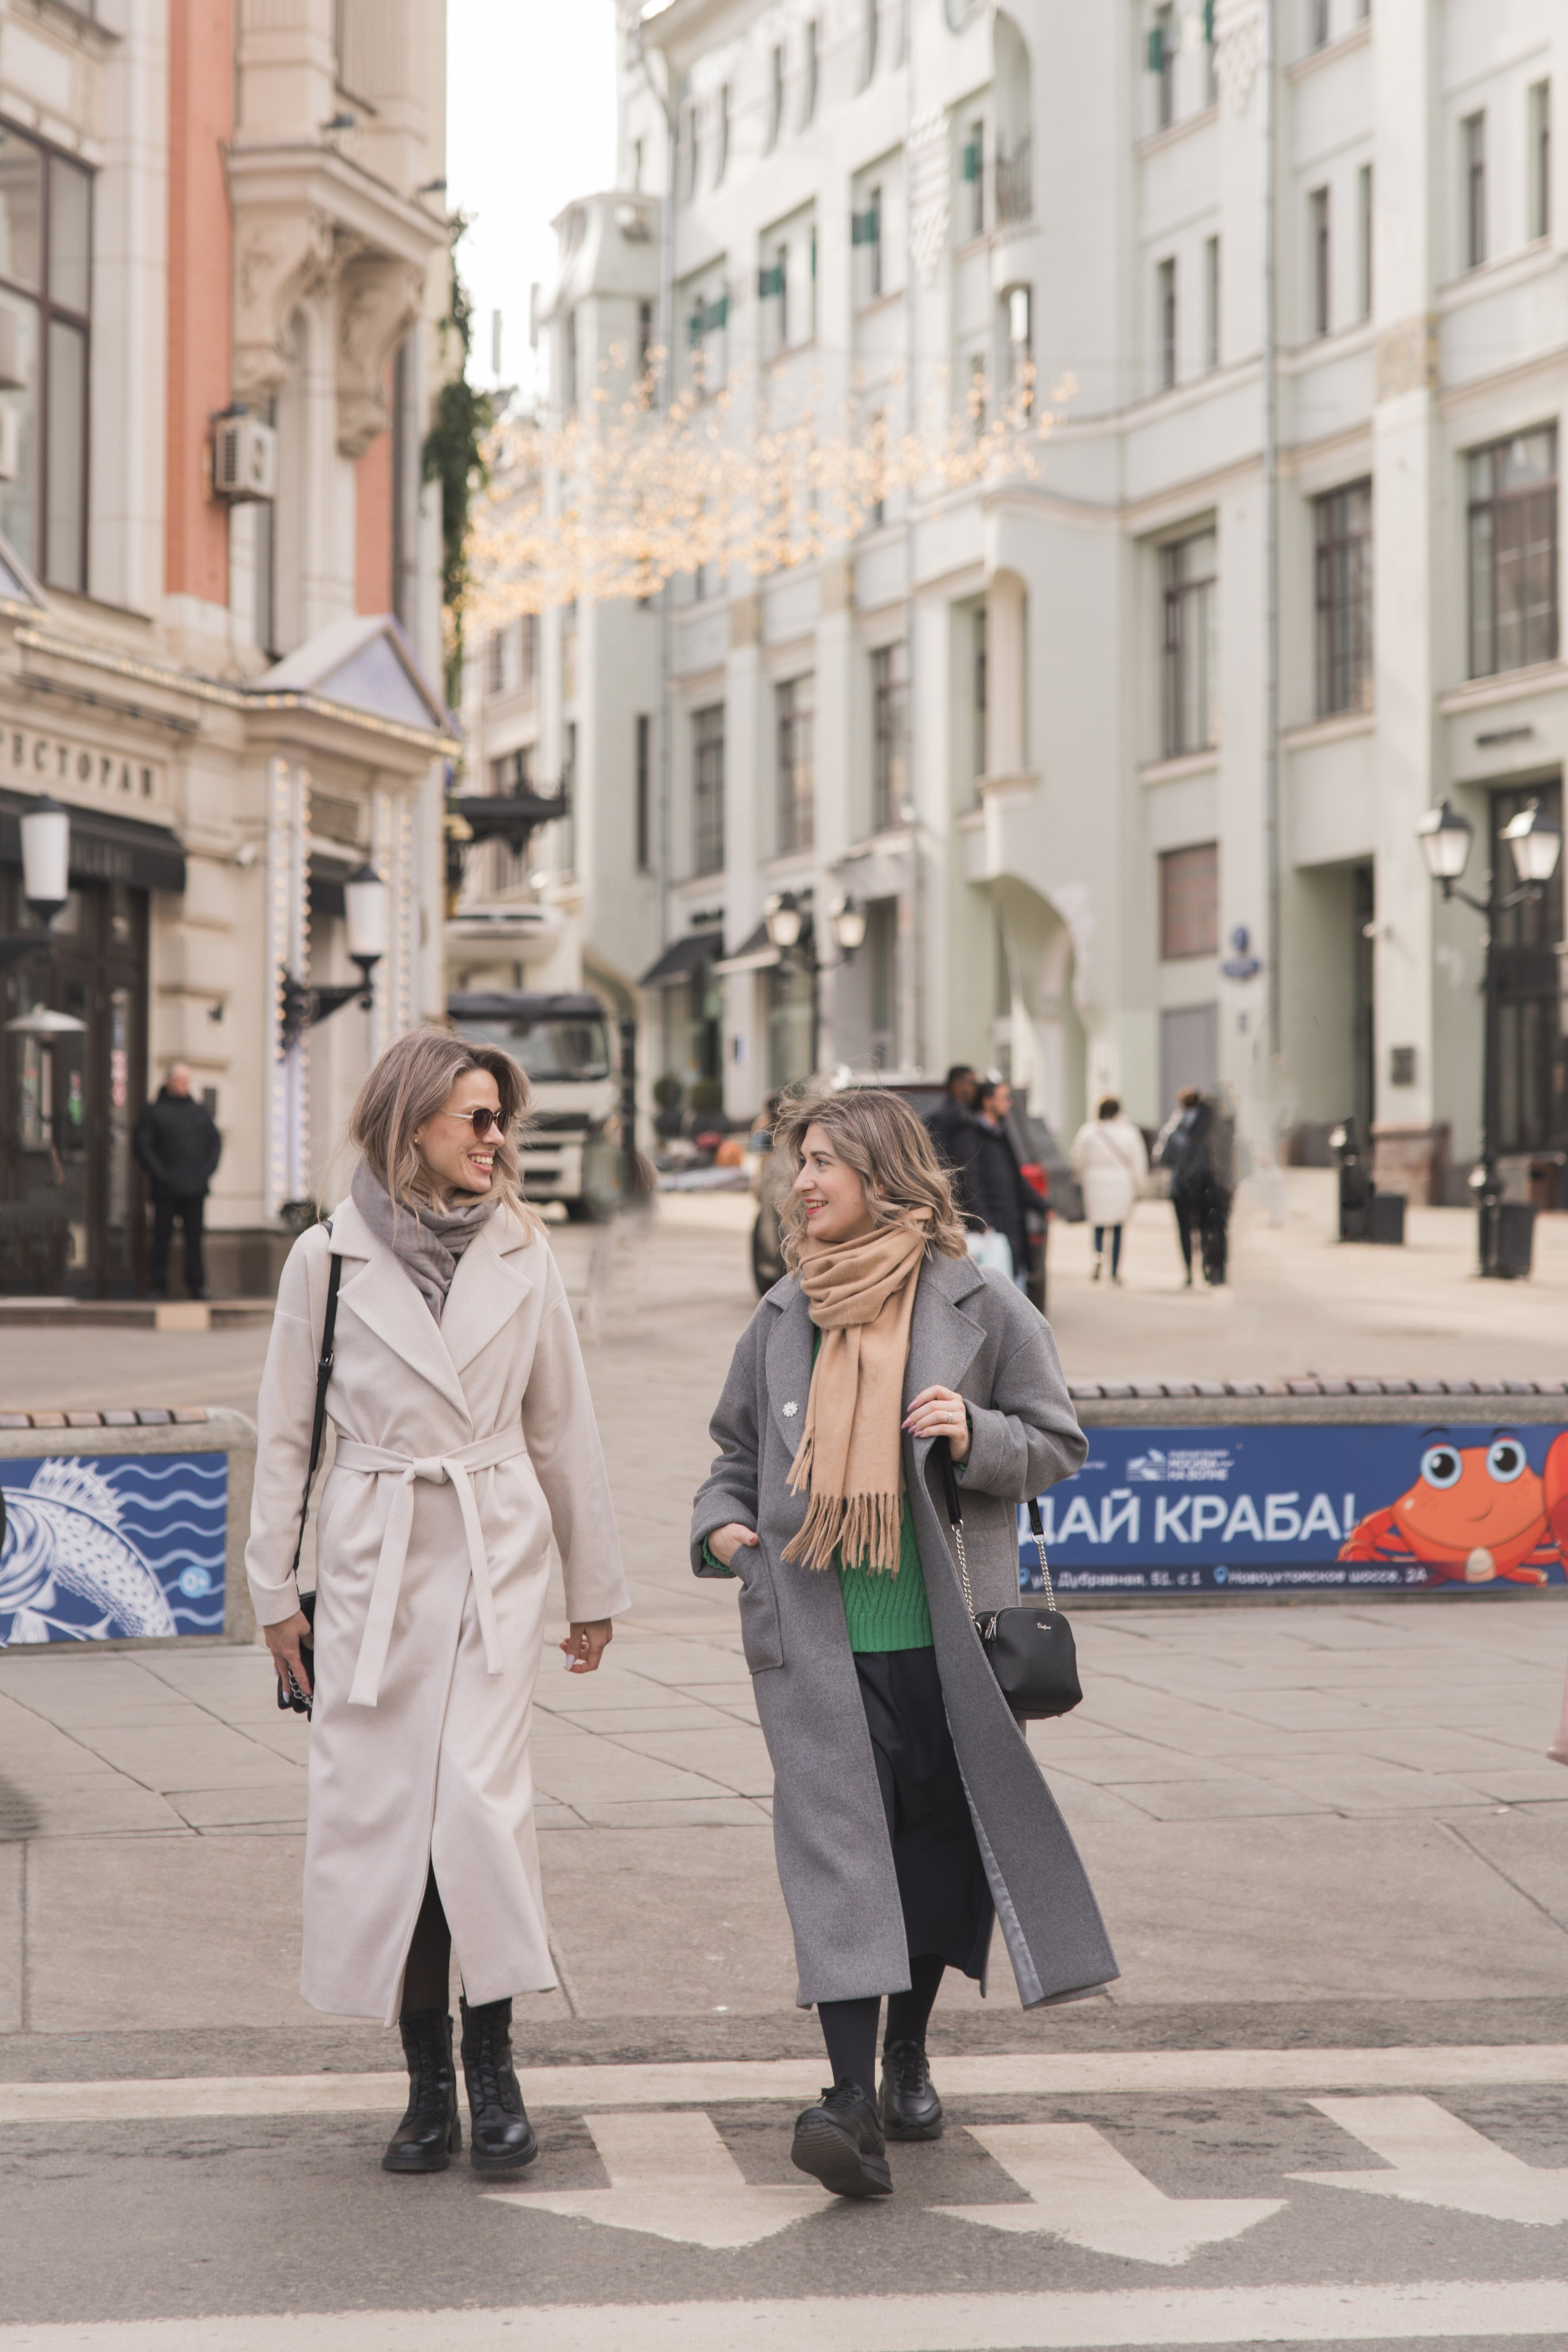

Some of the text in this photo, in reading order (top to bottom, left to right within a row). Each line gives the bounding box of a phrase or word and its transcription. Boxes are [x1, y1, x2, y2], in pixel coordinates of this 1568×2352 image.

[0, 728, 153, 797] ЕСТОРАН
[1155, 1492, 1355, 1543] КРАБА!
[1031, 1575, 1055, 1589] у.
